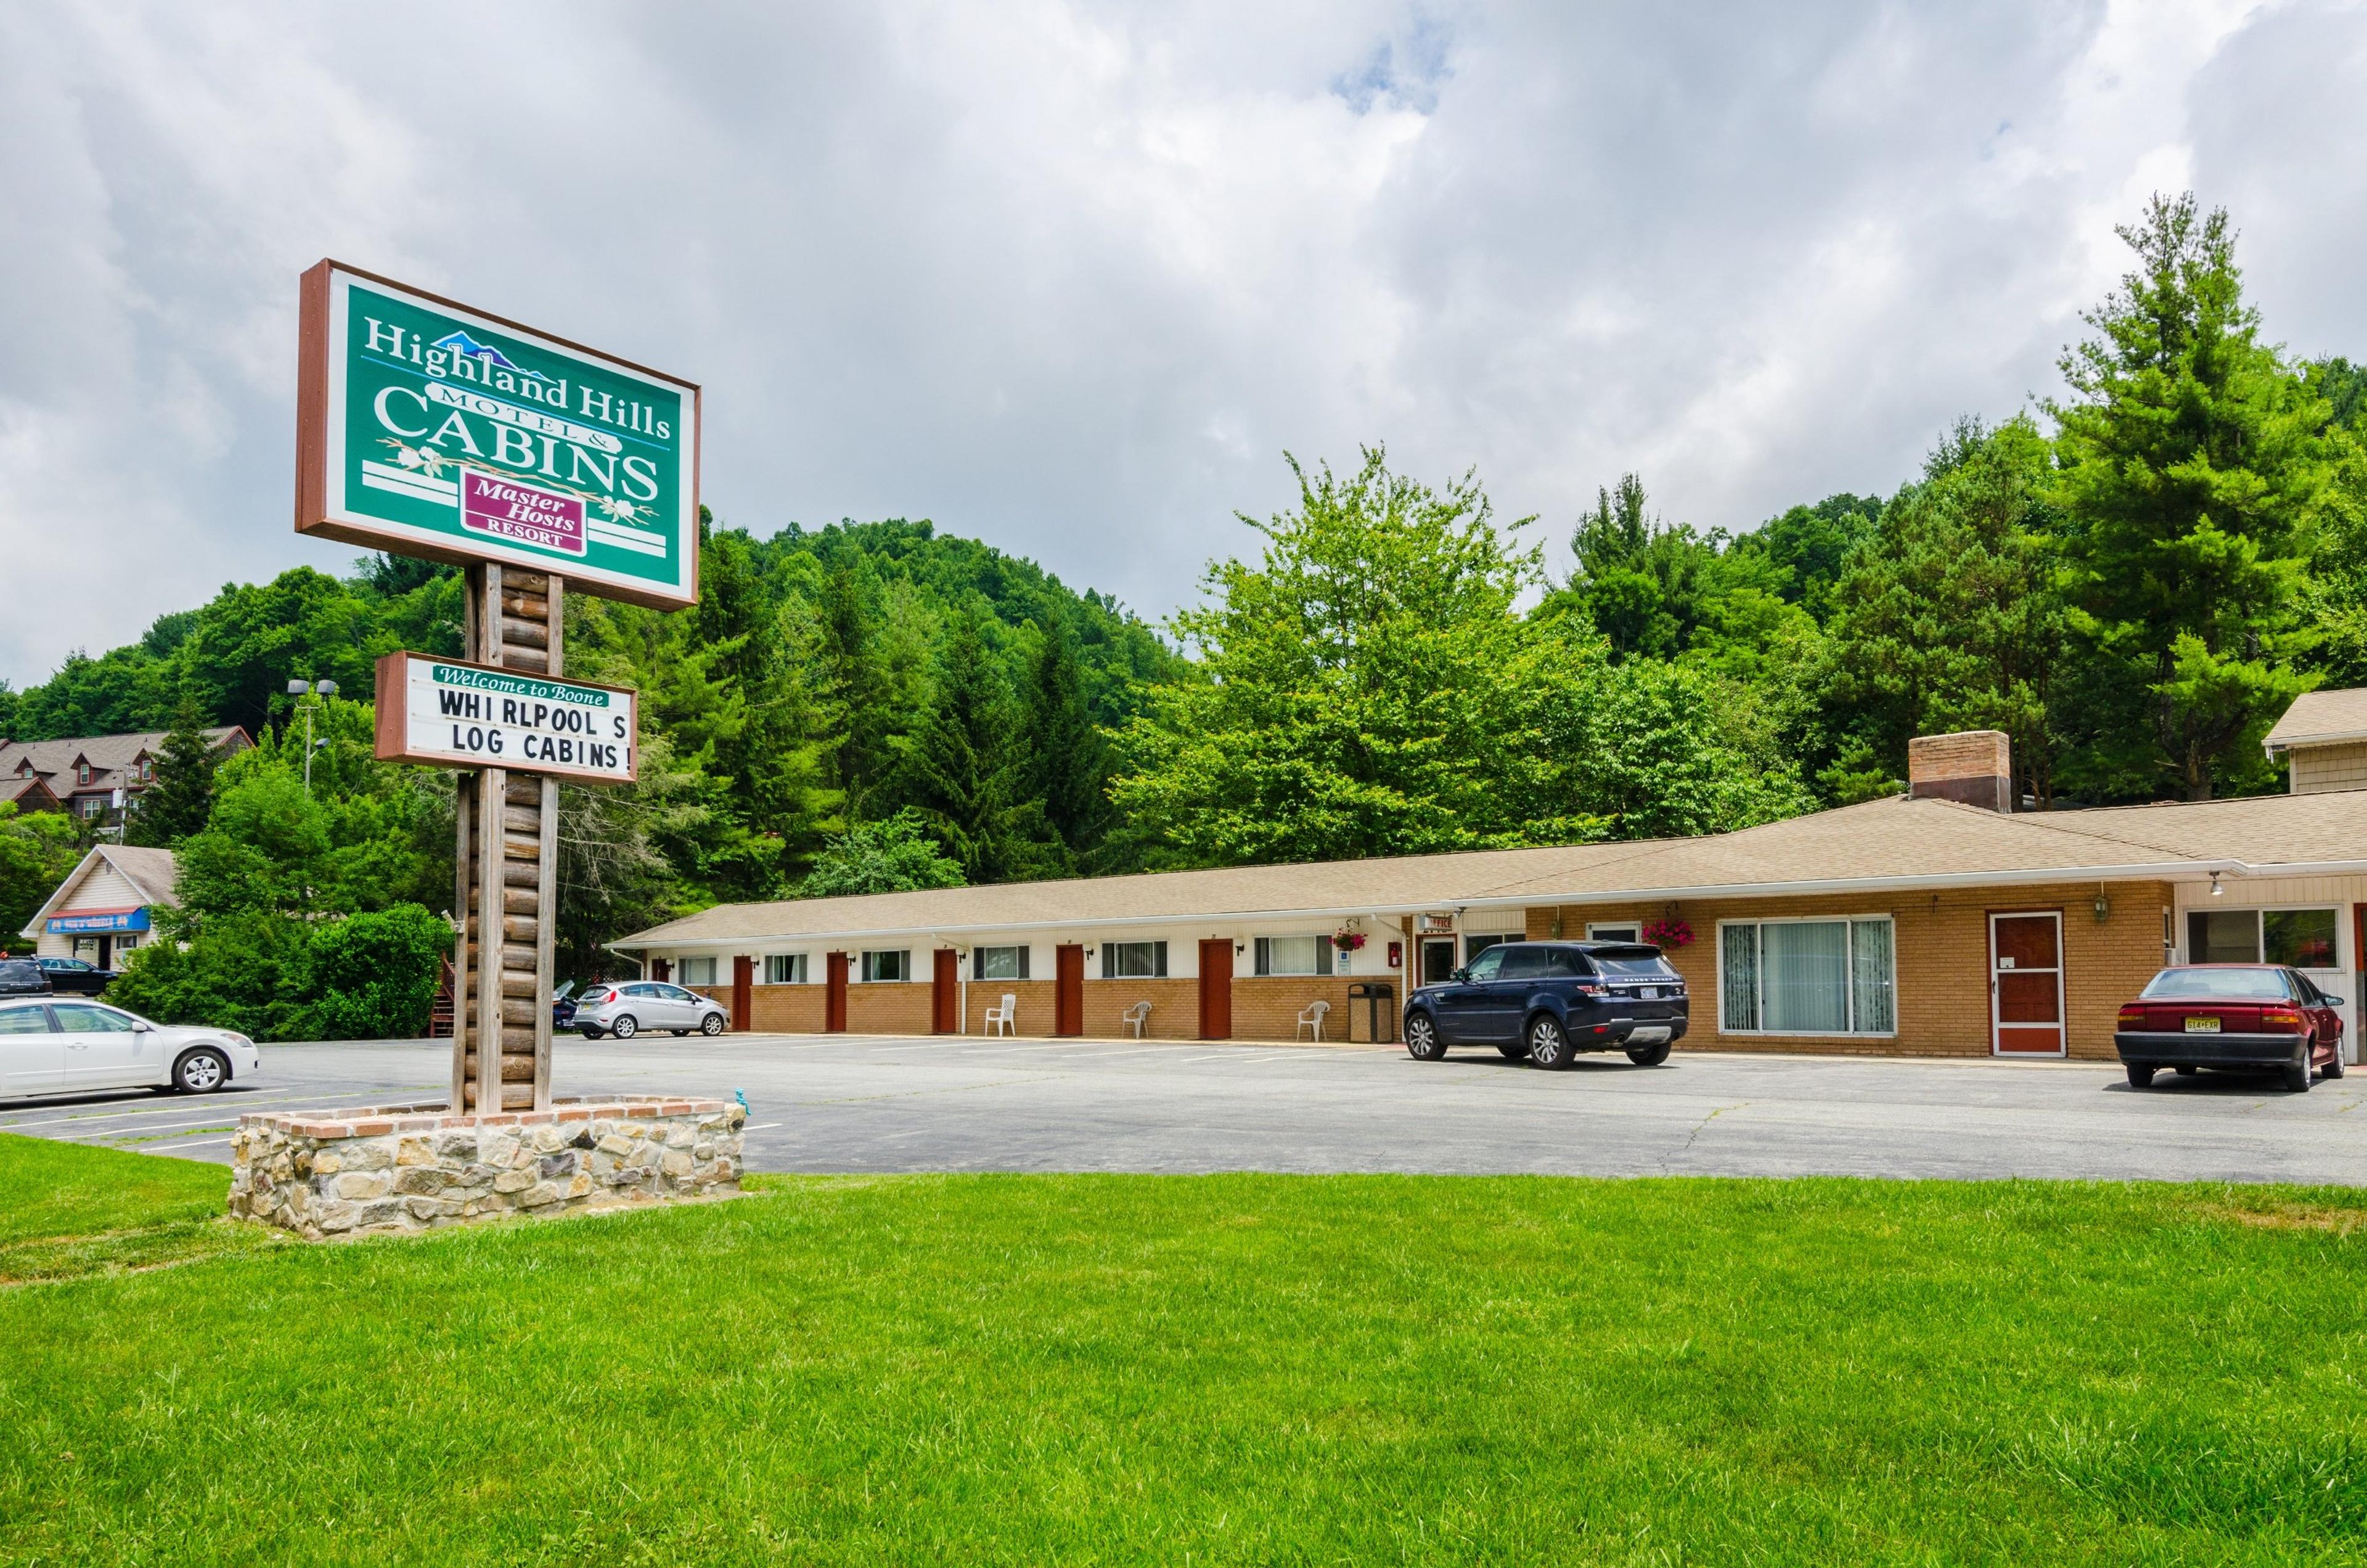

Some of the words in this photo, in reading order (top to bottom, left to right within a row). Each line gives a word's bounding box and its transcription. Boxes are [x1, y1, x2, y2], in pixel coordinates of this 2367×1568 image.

[363, 316, 569, 409] Highland
[578, 385, 671, 439] Hills
[441, 387, 578, 439] MOTEL
[588, 433, 609, 448] &
[374, 386, 658, 501] CABINS
[473, 478, 565, 513] Master
[486, 518, 563, 547] RESORT
[505, 502, 575, 531] Hosts
[439, 668, 525, 695] Welcome
[529, 685, 547, 698] to
[551, 685, 604, 706] Boone
[453, 724, 504, 754] LOG
